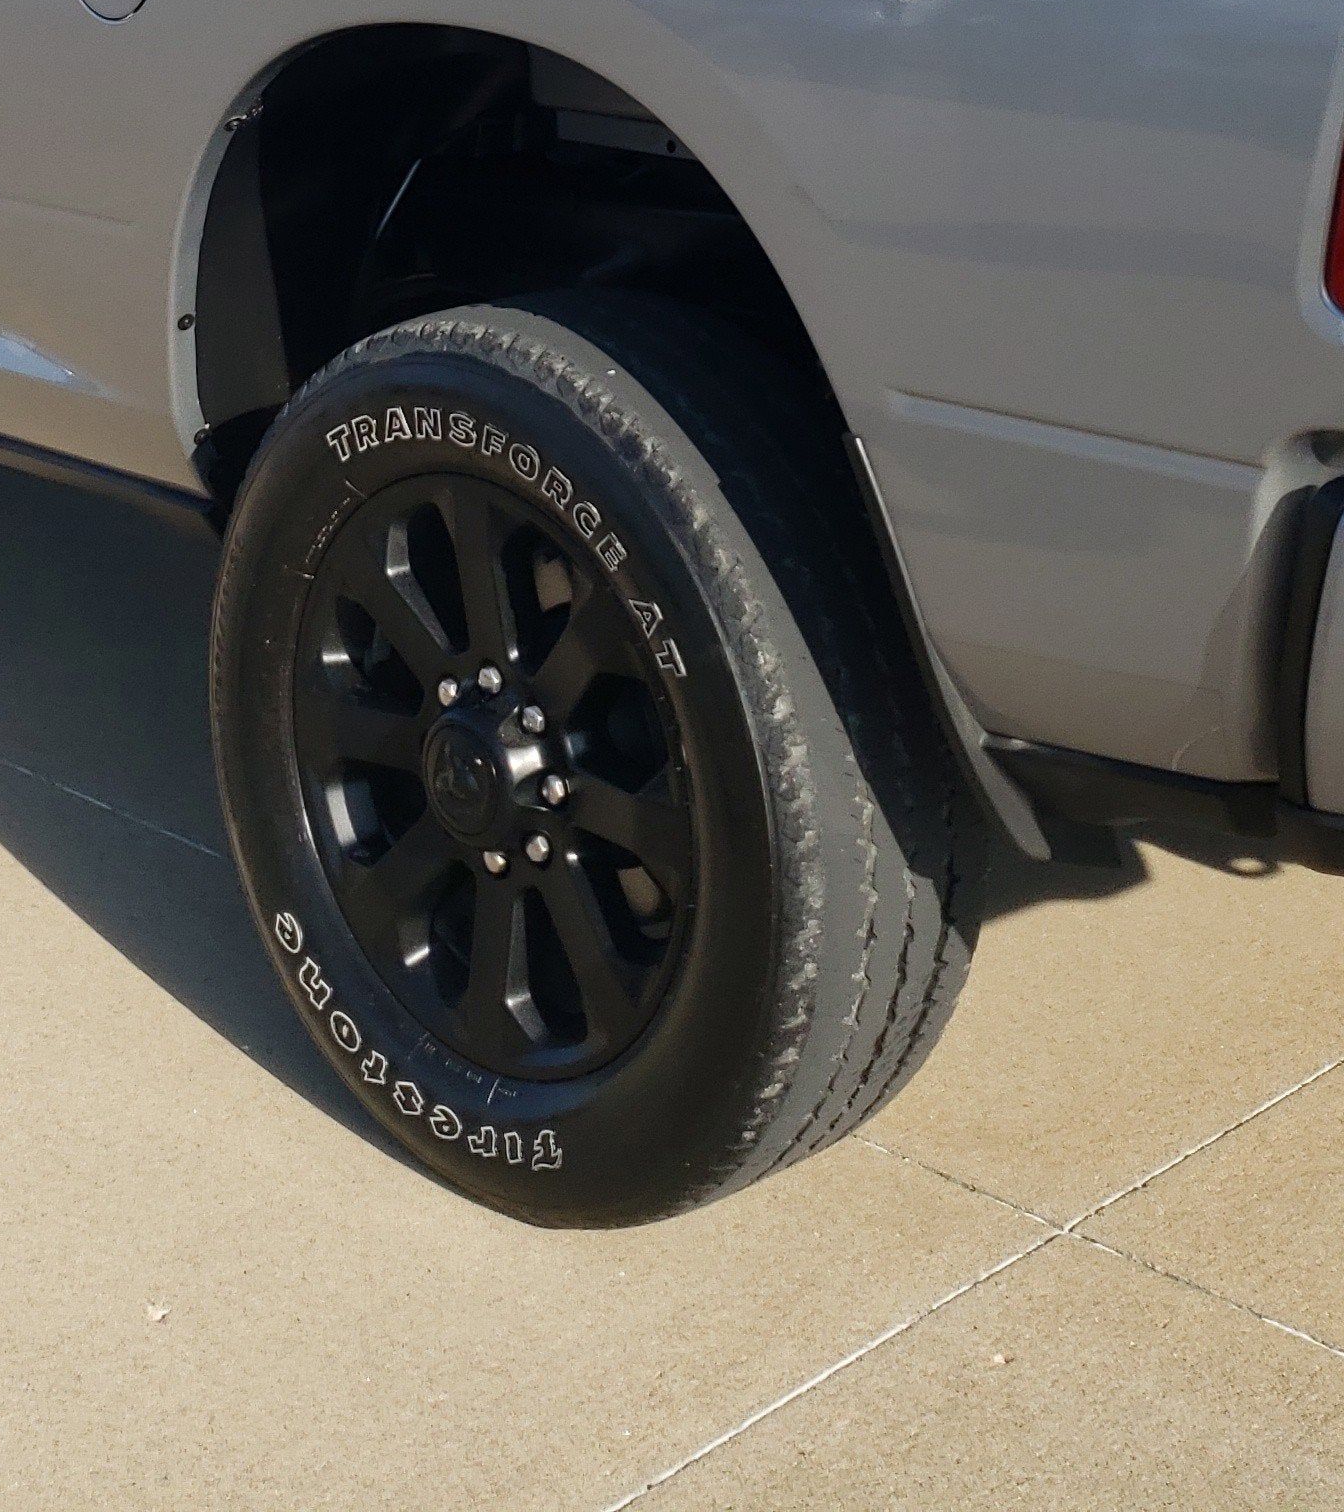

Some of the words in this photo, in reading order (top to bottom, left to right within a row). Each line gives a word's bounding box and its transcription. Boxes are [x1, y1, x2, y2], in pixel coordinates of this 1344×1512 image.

[325, 406, 628, 573] TRANSFORCE
[628, 597, 688, 679] AT
[273, 911, 564, 1172] Firestone
